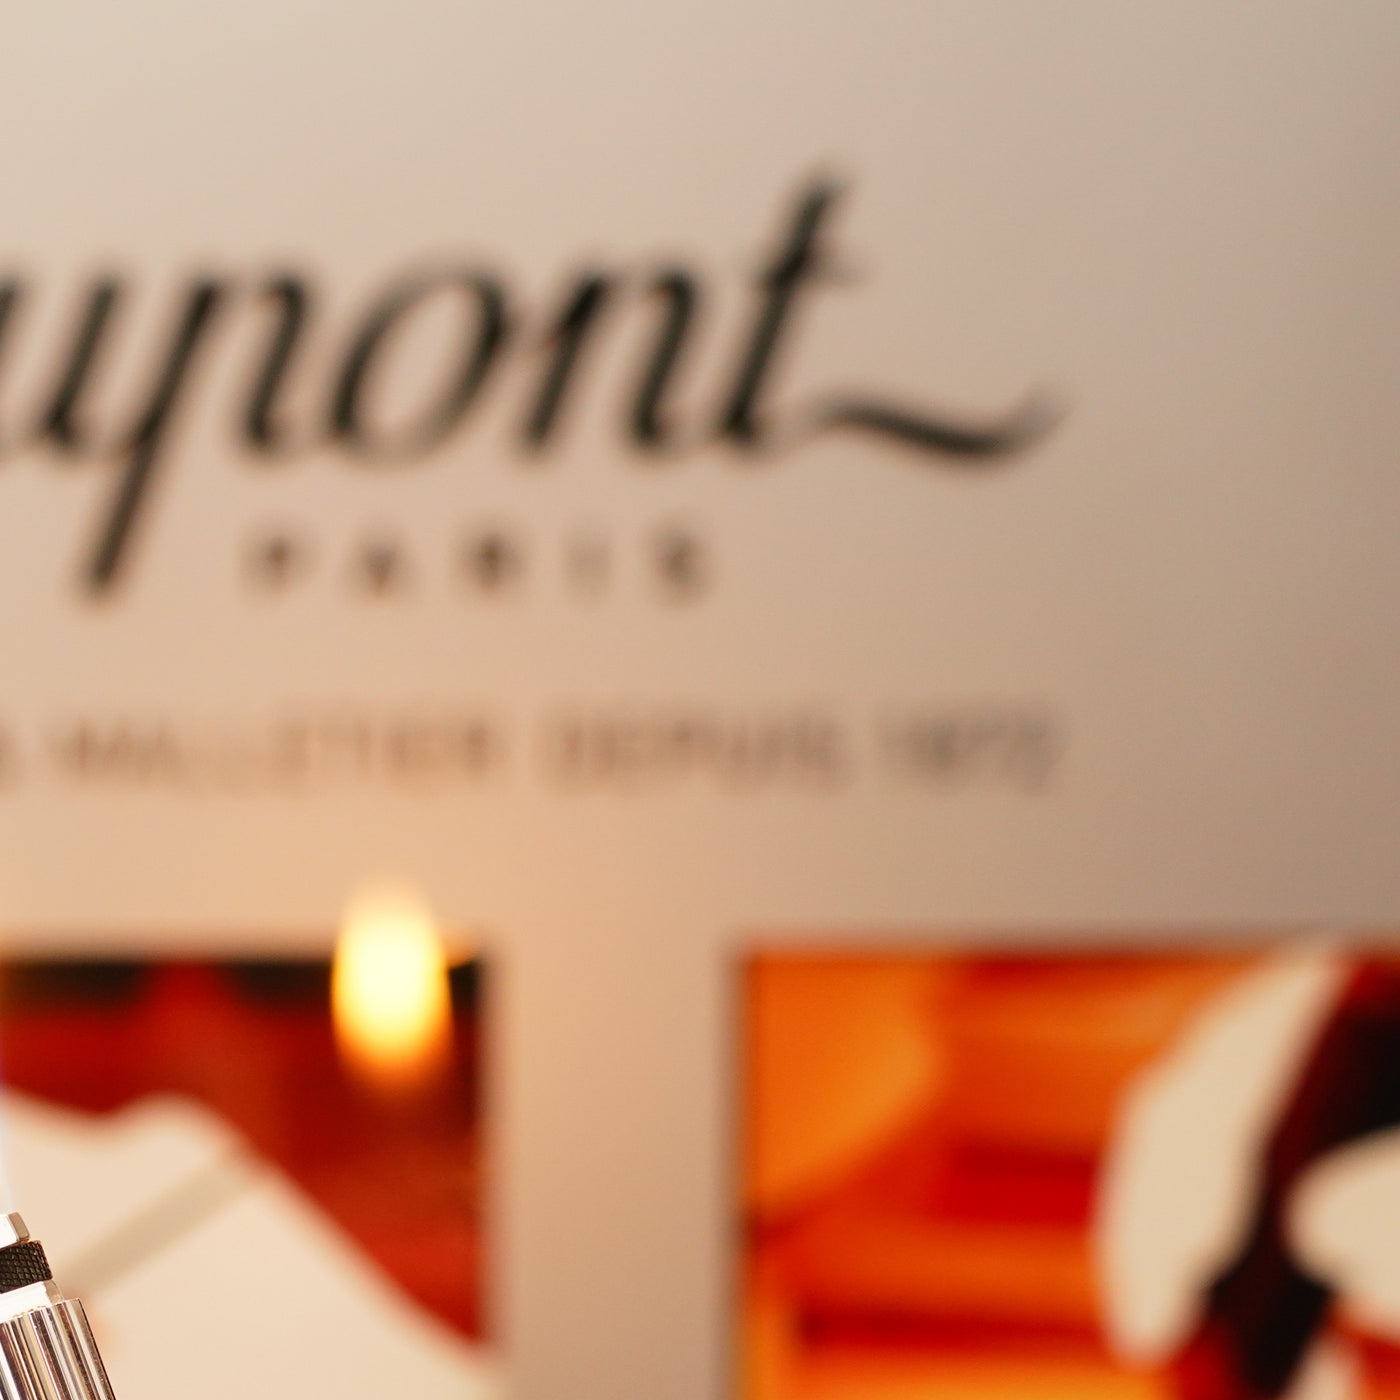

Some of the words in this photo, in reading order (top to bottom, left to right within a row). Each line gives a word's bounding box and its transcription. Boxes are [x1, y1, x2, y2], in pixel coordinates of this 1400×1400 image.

[243, 522, 712, 600] PARIS
[50, 706, 506, 792] MALLETIER
[544, 706, 850, 792] DEPUIS
